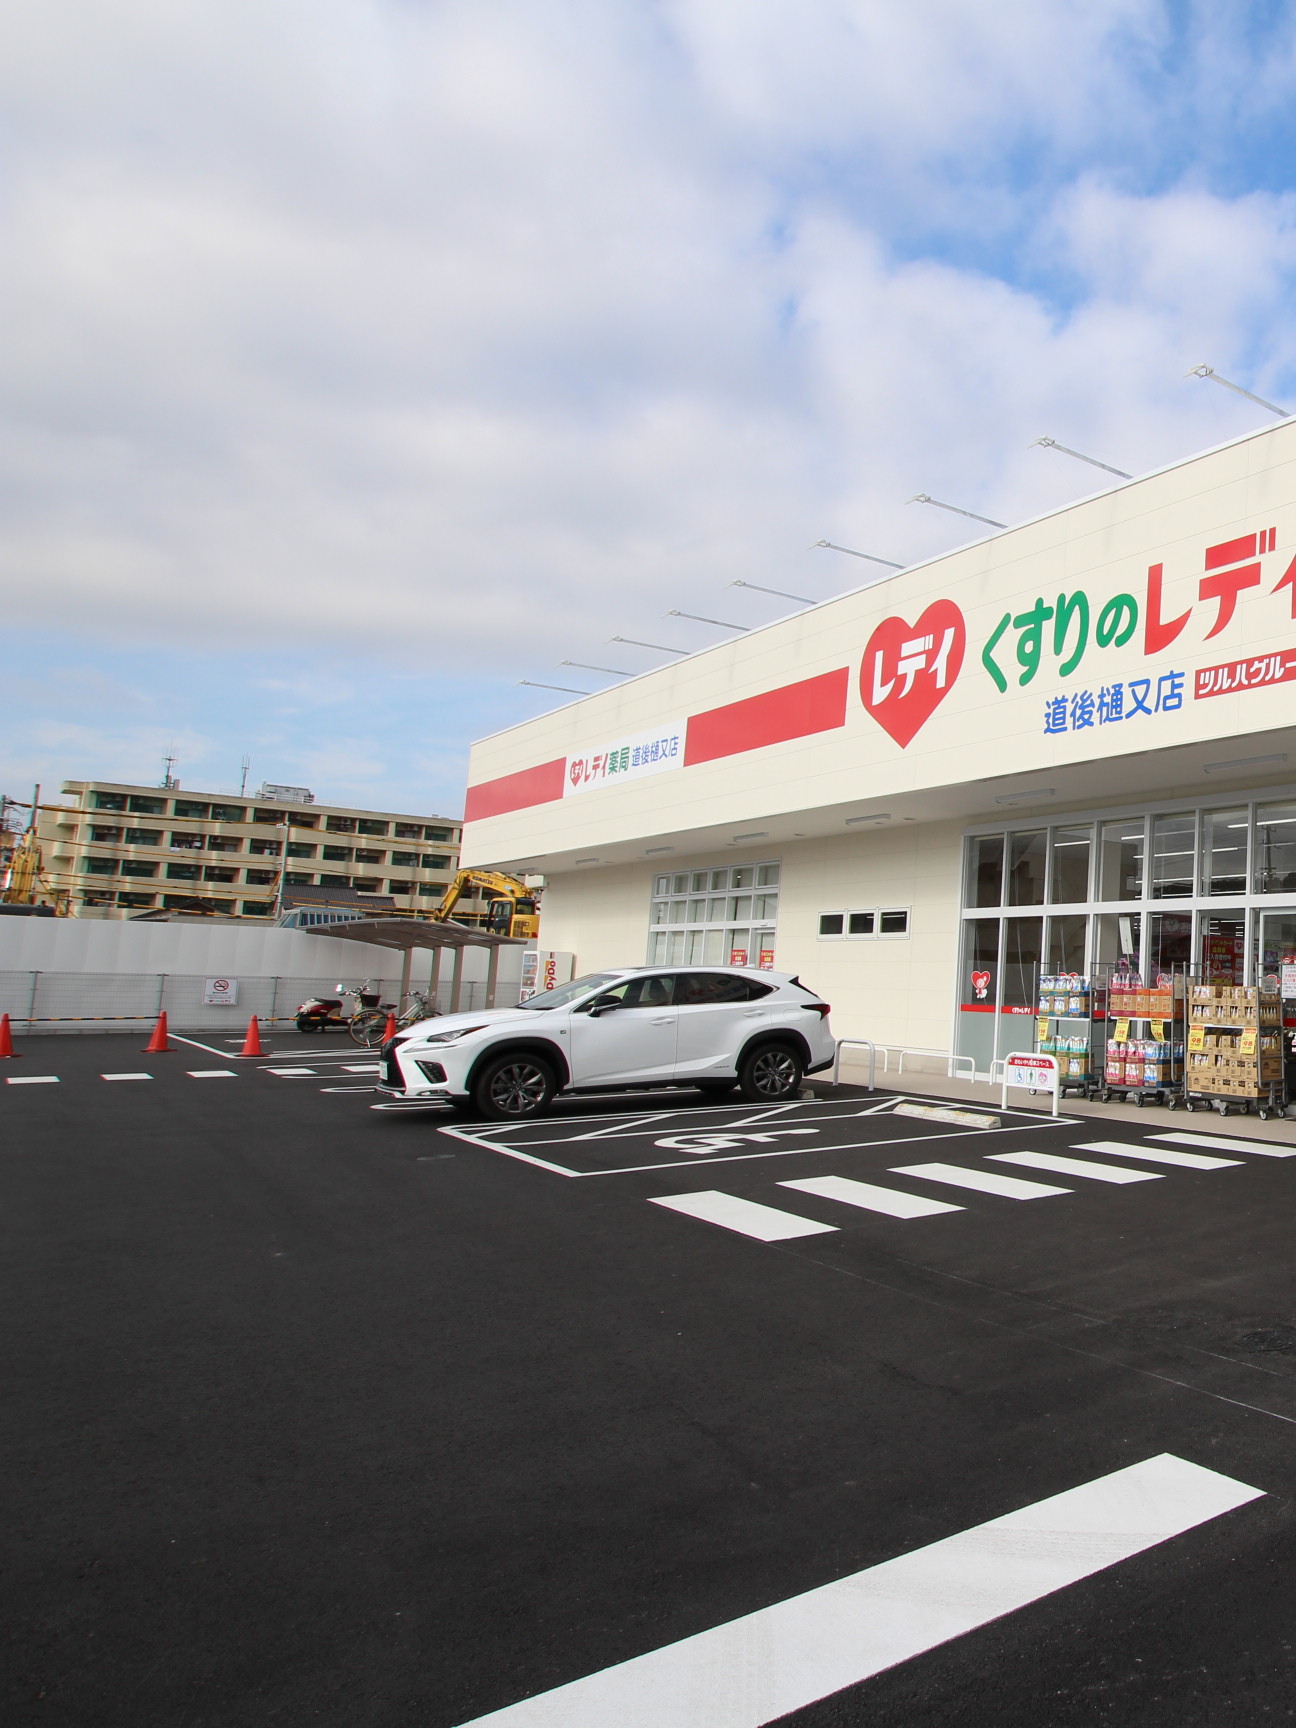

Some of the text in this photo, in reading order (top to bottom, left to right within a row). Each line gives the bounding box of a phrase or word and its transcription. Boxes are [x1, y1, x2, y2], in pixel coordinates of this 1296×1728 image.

[872, 627, 955, 706] レディ
[1043, 670, 1185, 735] 道後樋又店
[584, 746, 630, 783] レディ薬局
[546, 960, 557, 990] DyDo
